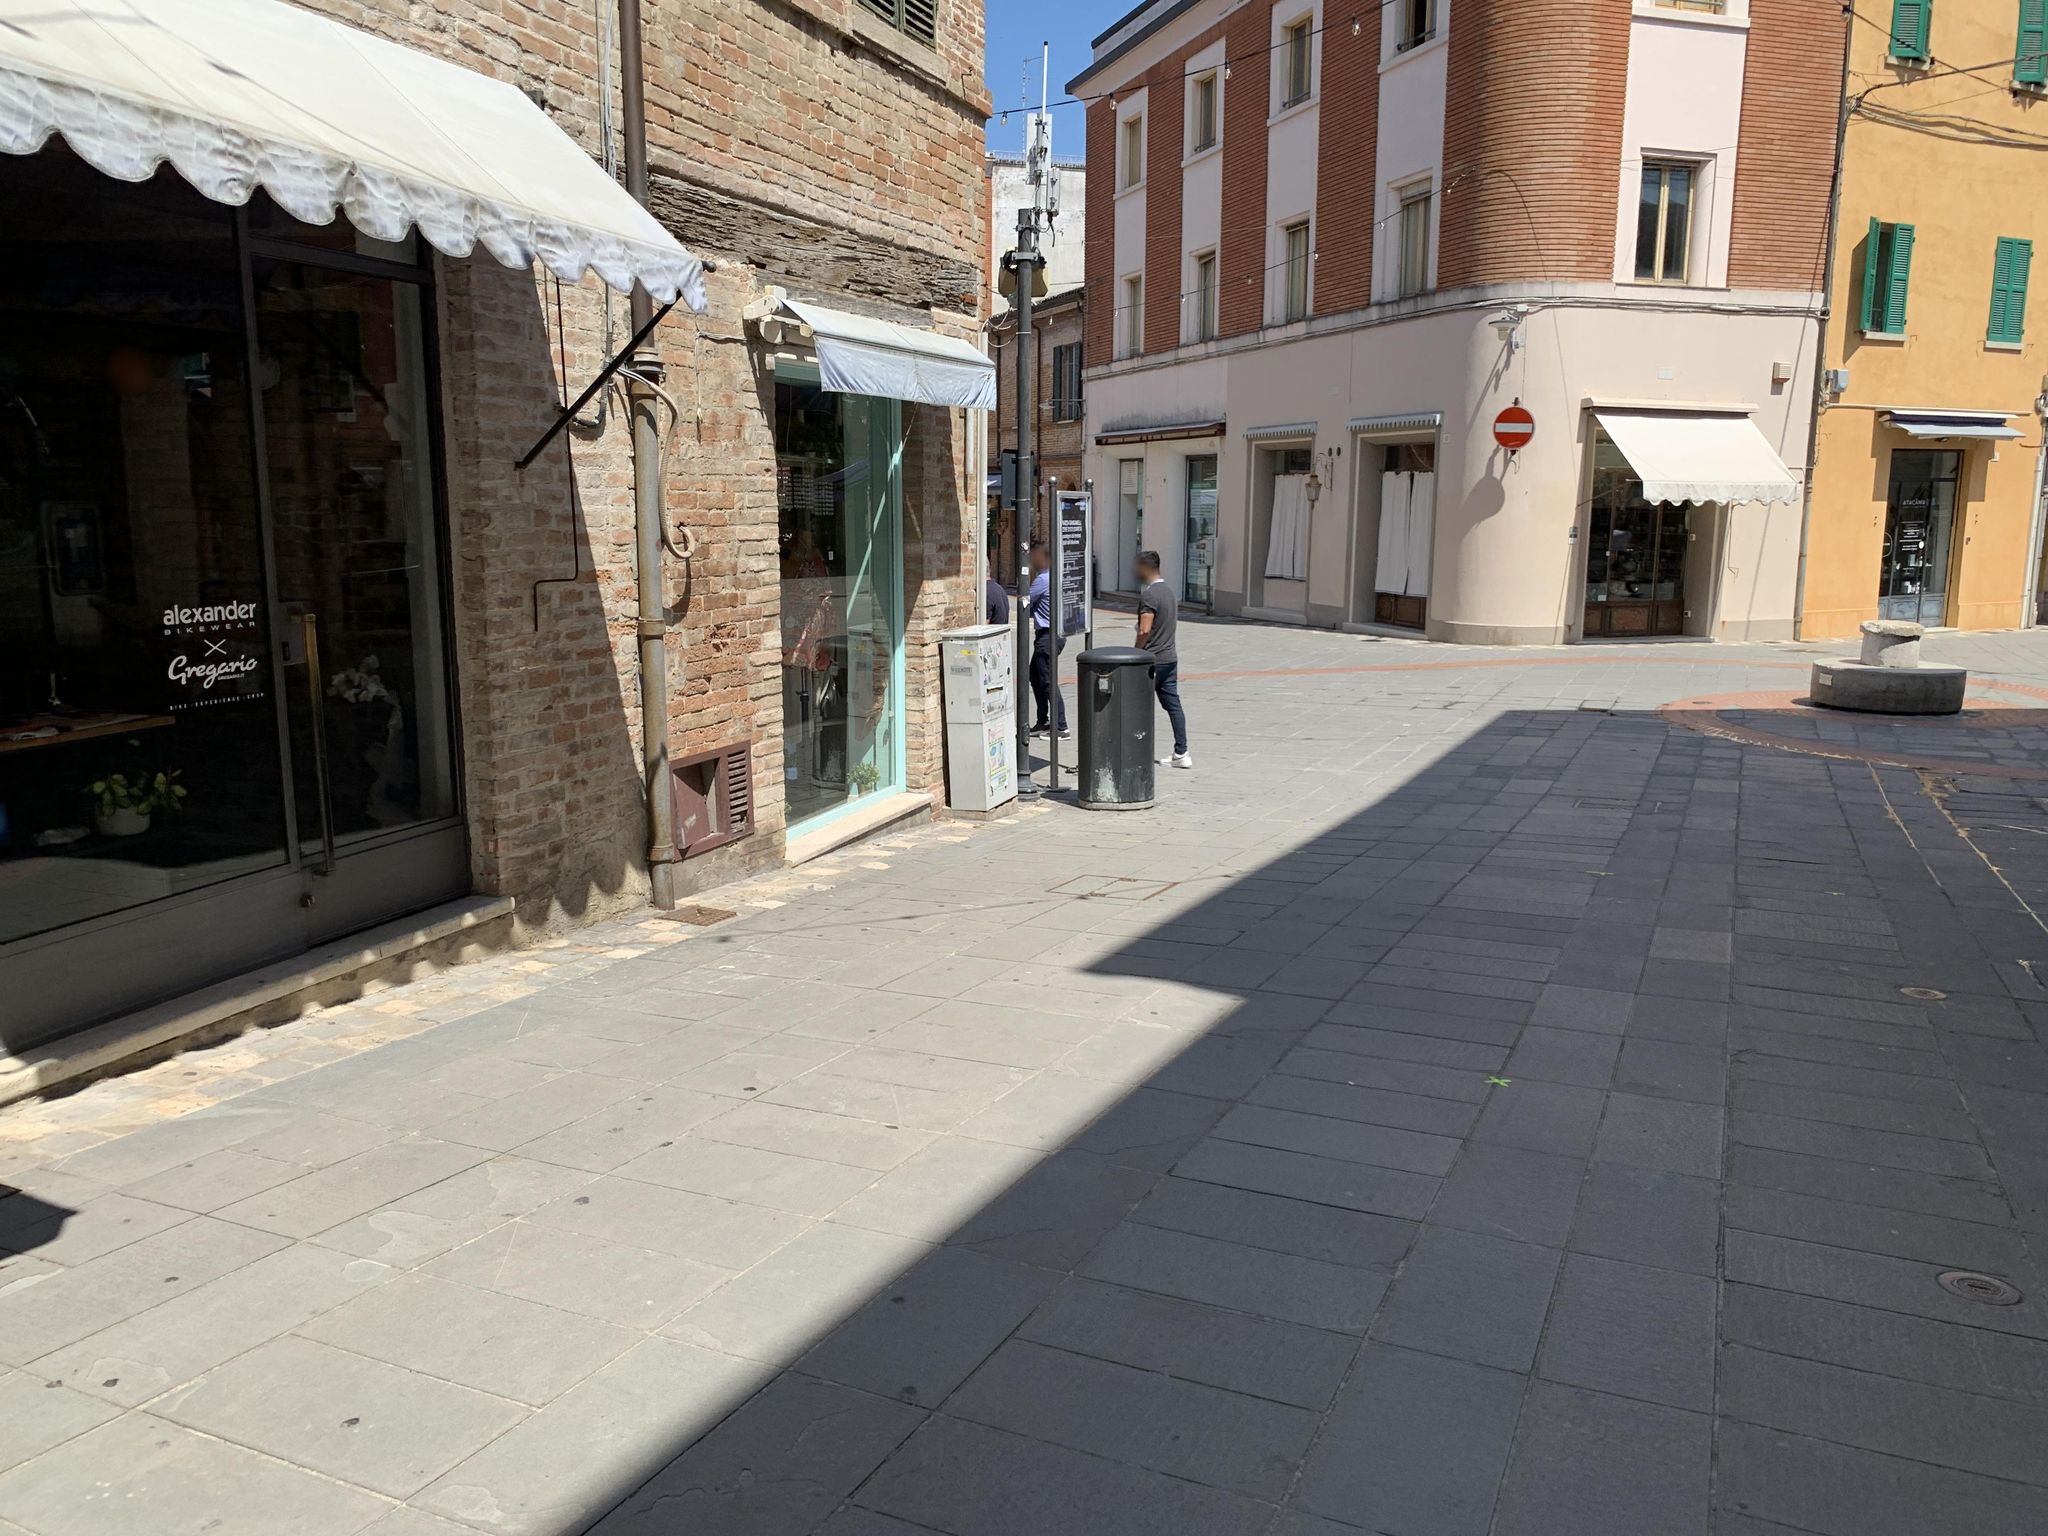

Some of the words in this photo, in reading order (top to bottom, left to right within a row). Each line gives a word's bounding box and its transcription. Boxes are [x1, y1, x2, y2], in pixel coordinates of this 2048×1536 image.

[163, 600, 257, 626] alexander
[164, 621, 256, 636] BIKEWEAR
[168, 655, 258, 689] Gregario
